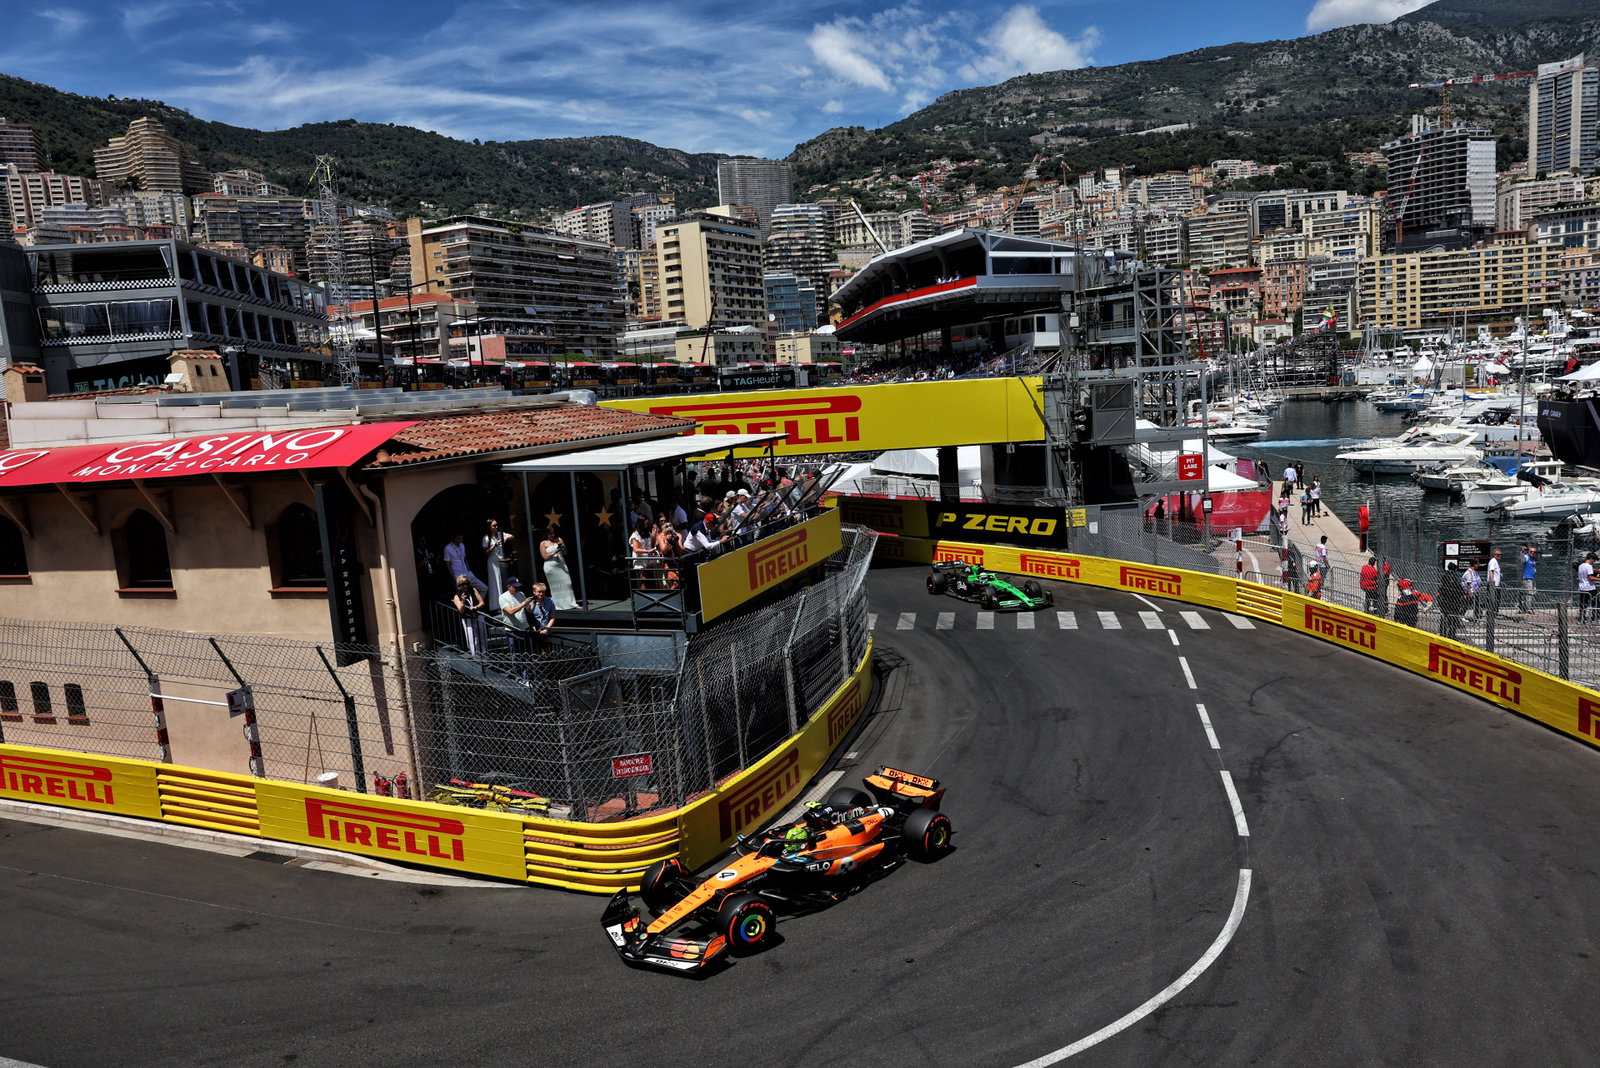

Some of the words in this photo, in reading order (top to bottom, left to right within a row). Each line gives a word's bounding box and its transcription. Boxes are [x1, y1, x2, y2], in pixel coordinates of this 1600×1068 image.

[733, 375, 780, 386] TAGHeuer
[106, 429, 344, 463] CASINO
[936, 513, 957, 526] P
[963, 513, 1057, 536] ZERO
[340, 549, 346, 565] LA
[747, 528, 808, 591] PIRELLI
[932, 544, 984, 566] PIRELLI
[1020, 554, 1080, 579] PIRELLI
[1120, 566, 1182, 596] PIRELLI
[343, 571, 356, 642] RASCASSE
[1305, 604, 1376, 650] PIRELLI
[1428, 642, 1522, 705] PIRELLI
[827, 679, 861, 747] PIRELLI
[0, 755, 114, 805] PIRELLI
[718, 748, 800, 843] PIRELLI
[304, 797, 464, 862] PIRELLI
[831, 806, 865, 825] Chrome
